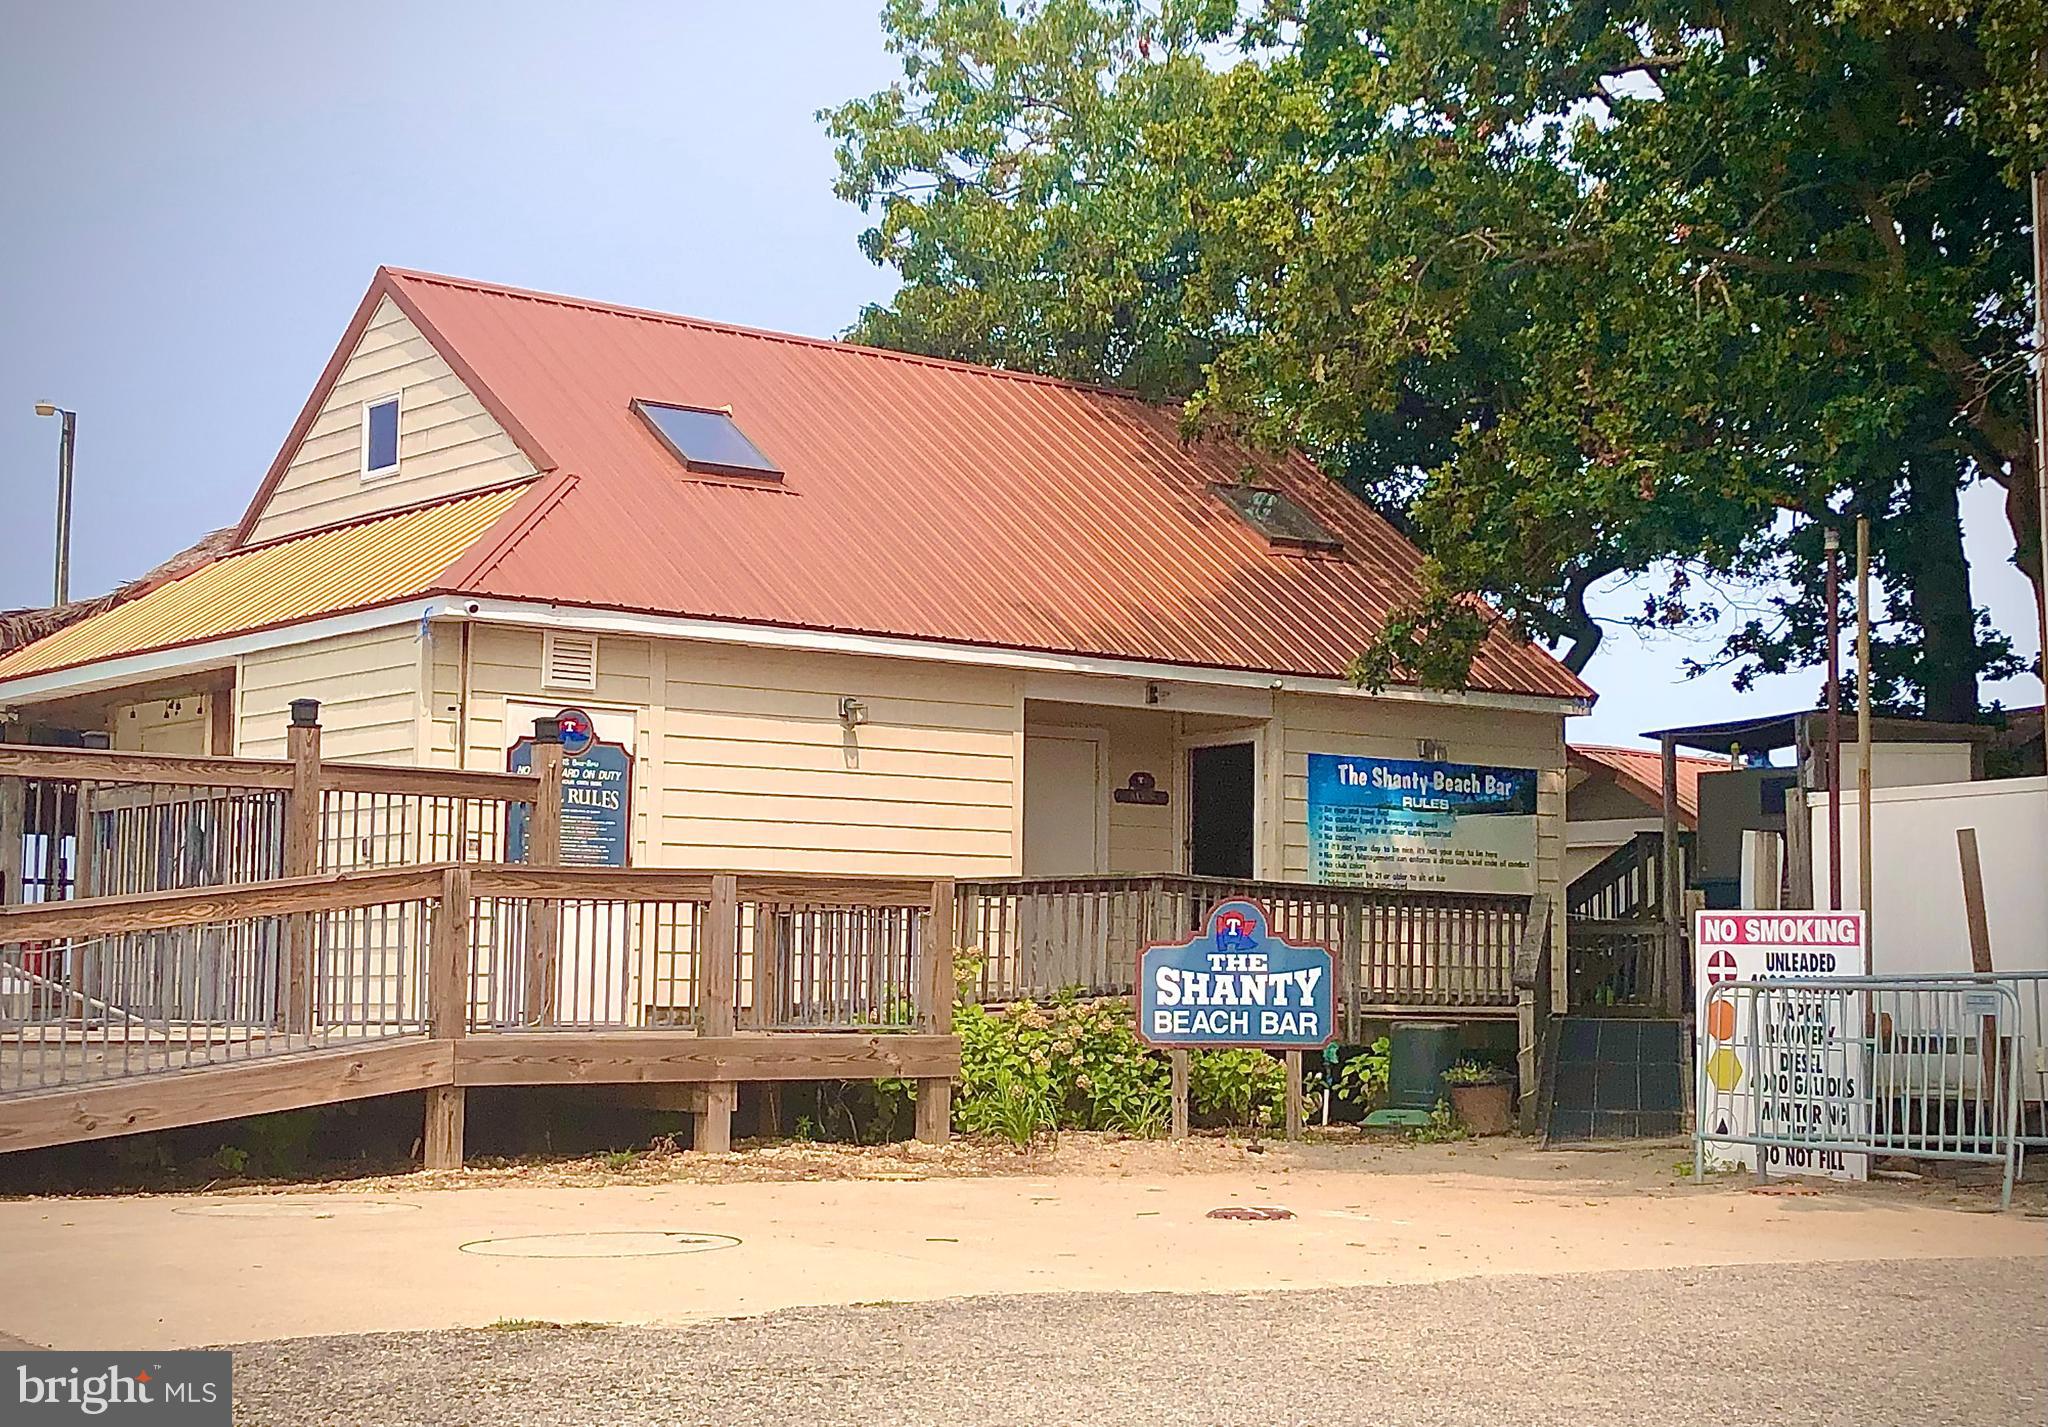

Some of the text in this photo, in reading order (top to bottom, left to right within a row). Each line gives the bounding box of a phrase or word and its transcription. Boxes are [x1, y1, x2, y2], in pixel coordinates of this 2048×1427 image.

[582, 770, 595, 779] ON
[599, 771, 622, 781] DUTY
[1337, 764, 1512, 796] The Shanty Beach Bar
[568, 788, 619, 810] RULES
[1402, 796, 1449, 810] RULES
[1324, 824, 1333, 832] No
[1355, 845, 1367, 853] your
[1371, 844, 1381, 853] day
[1392, 845, 1399, 853] be
[1356, 852, 1394, 862] Management
[1375, 872, 1382, 880] 21
[1226, 918, 1241, 936] T
[1704, 918, 1855, 943] NO SMOKING
[1206, 953, 1268, 972] THE
[1766, 952, 1836, 972] UNLEADED
[1155, 966, 1322, 1007] SHANTY
[1154, 1010, 1318, 1036] BEACH BAR
[1761, 1101, 1846, 1126] MNTORNG
[1786, 1148, 1813, 1167] NOT
[1819, 1150, 1845, 1171] FILL
